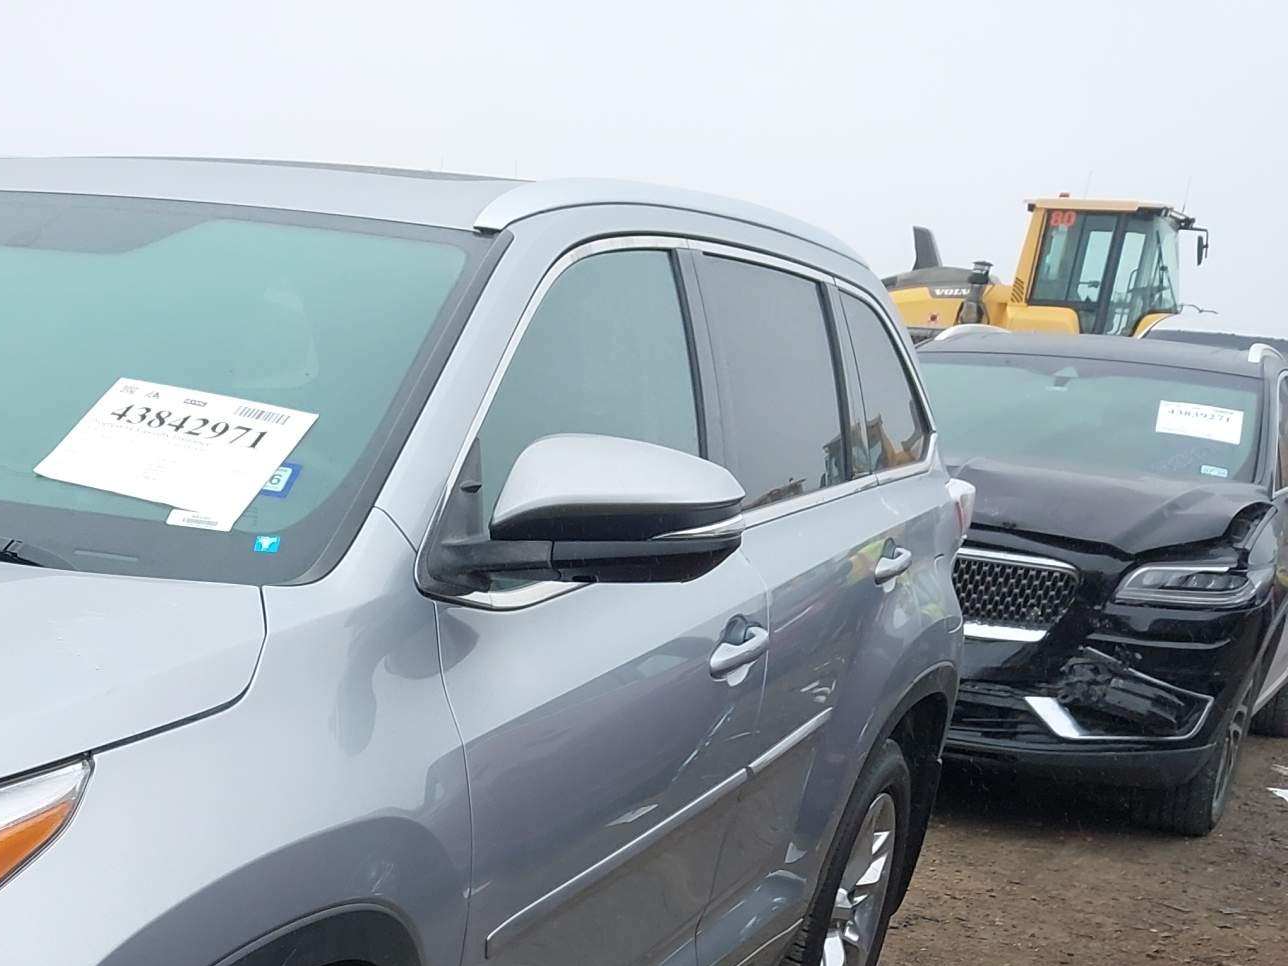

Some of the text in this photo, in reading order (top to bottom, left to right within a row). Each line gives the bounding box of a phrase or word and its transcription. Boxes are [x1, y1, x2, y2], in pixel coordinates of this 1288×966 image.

[1050, 210, 1077, 226] 80
[934, 288, 971, 296] VOLV
[110, 403, 268, 449] 43842971
[269, 473, 283, 486] 6
